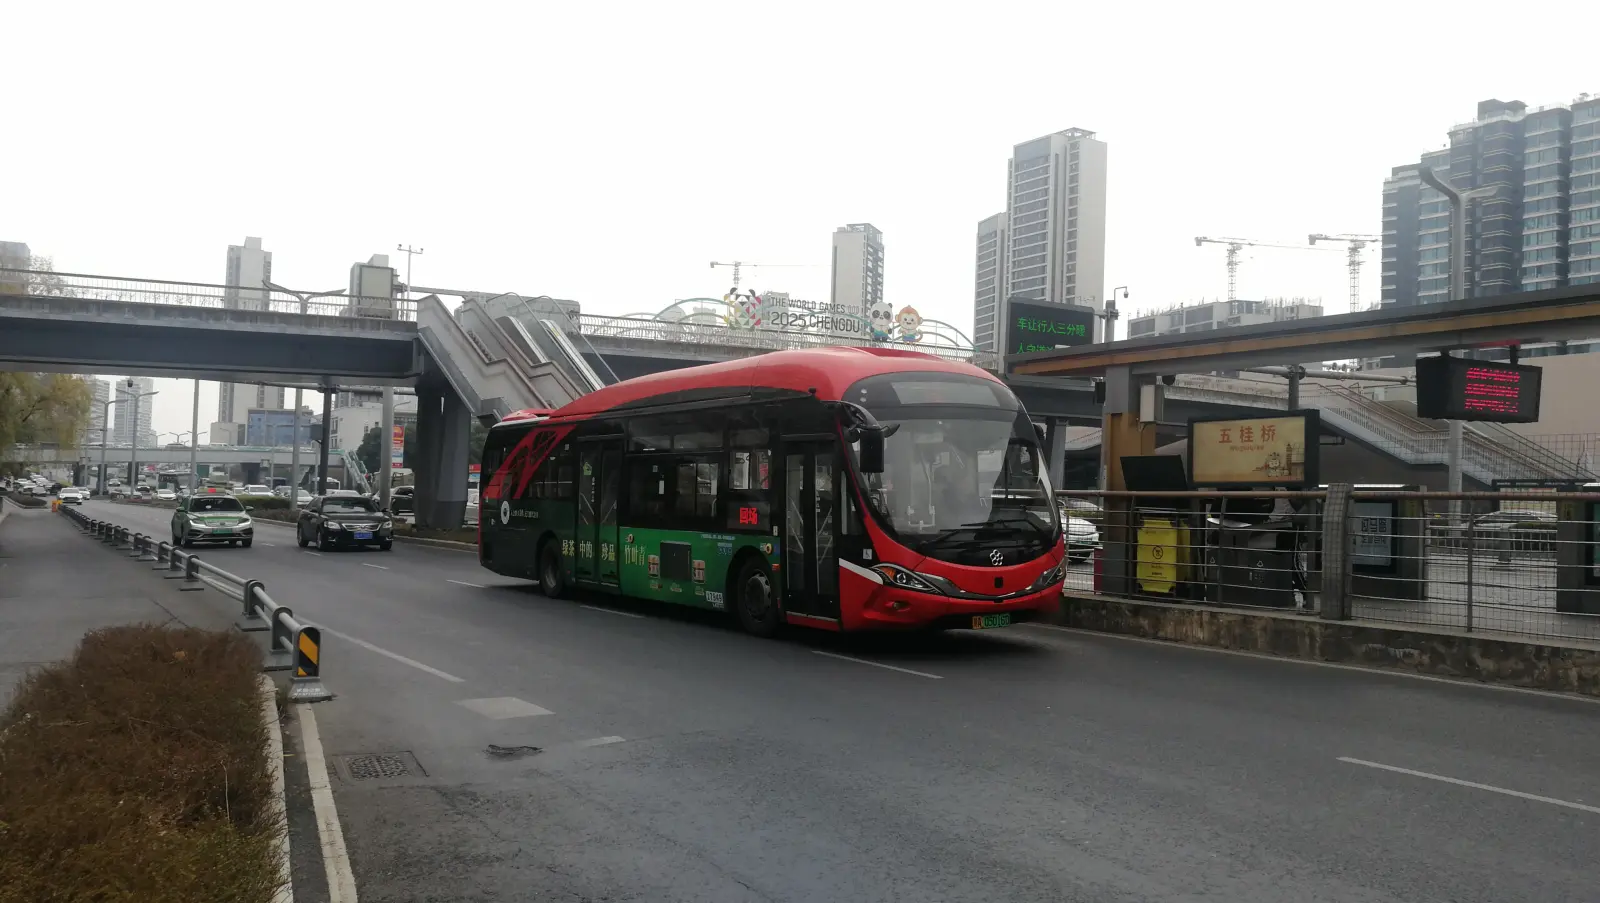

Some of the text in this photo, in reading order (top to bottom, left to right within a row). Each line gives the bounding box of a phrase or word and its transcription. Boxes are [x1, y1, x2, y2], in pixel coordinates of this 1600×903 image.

[770, 296, 846, 314] THE WORLD GAMES
[770, 311, 860, 333] 2025 CHENGDU
[1017, 316, 1086, 337] 车让行人三分暖
[1218, 424, 1276, 443] 五桂桥
[739, 507, 758, 525] 回场
